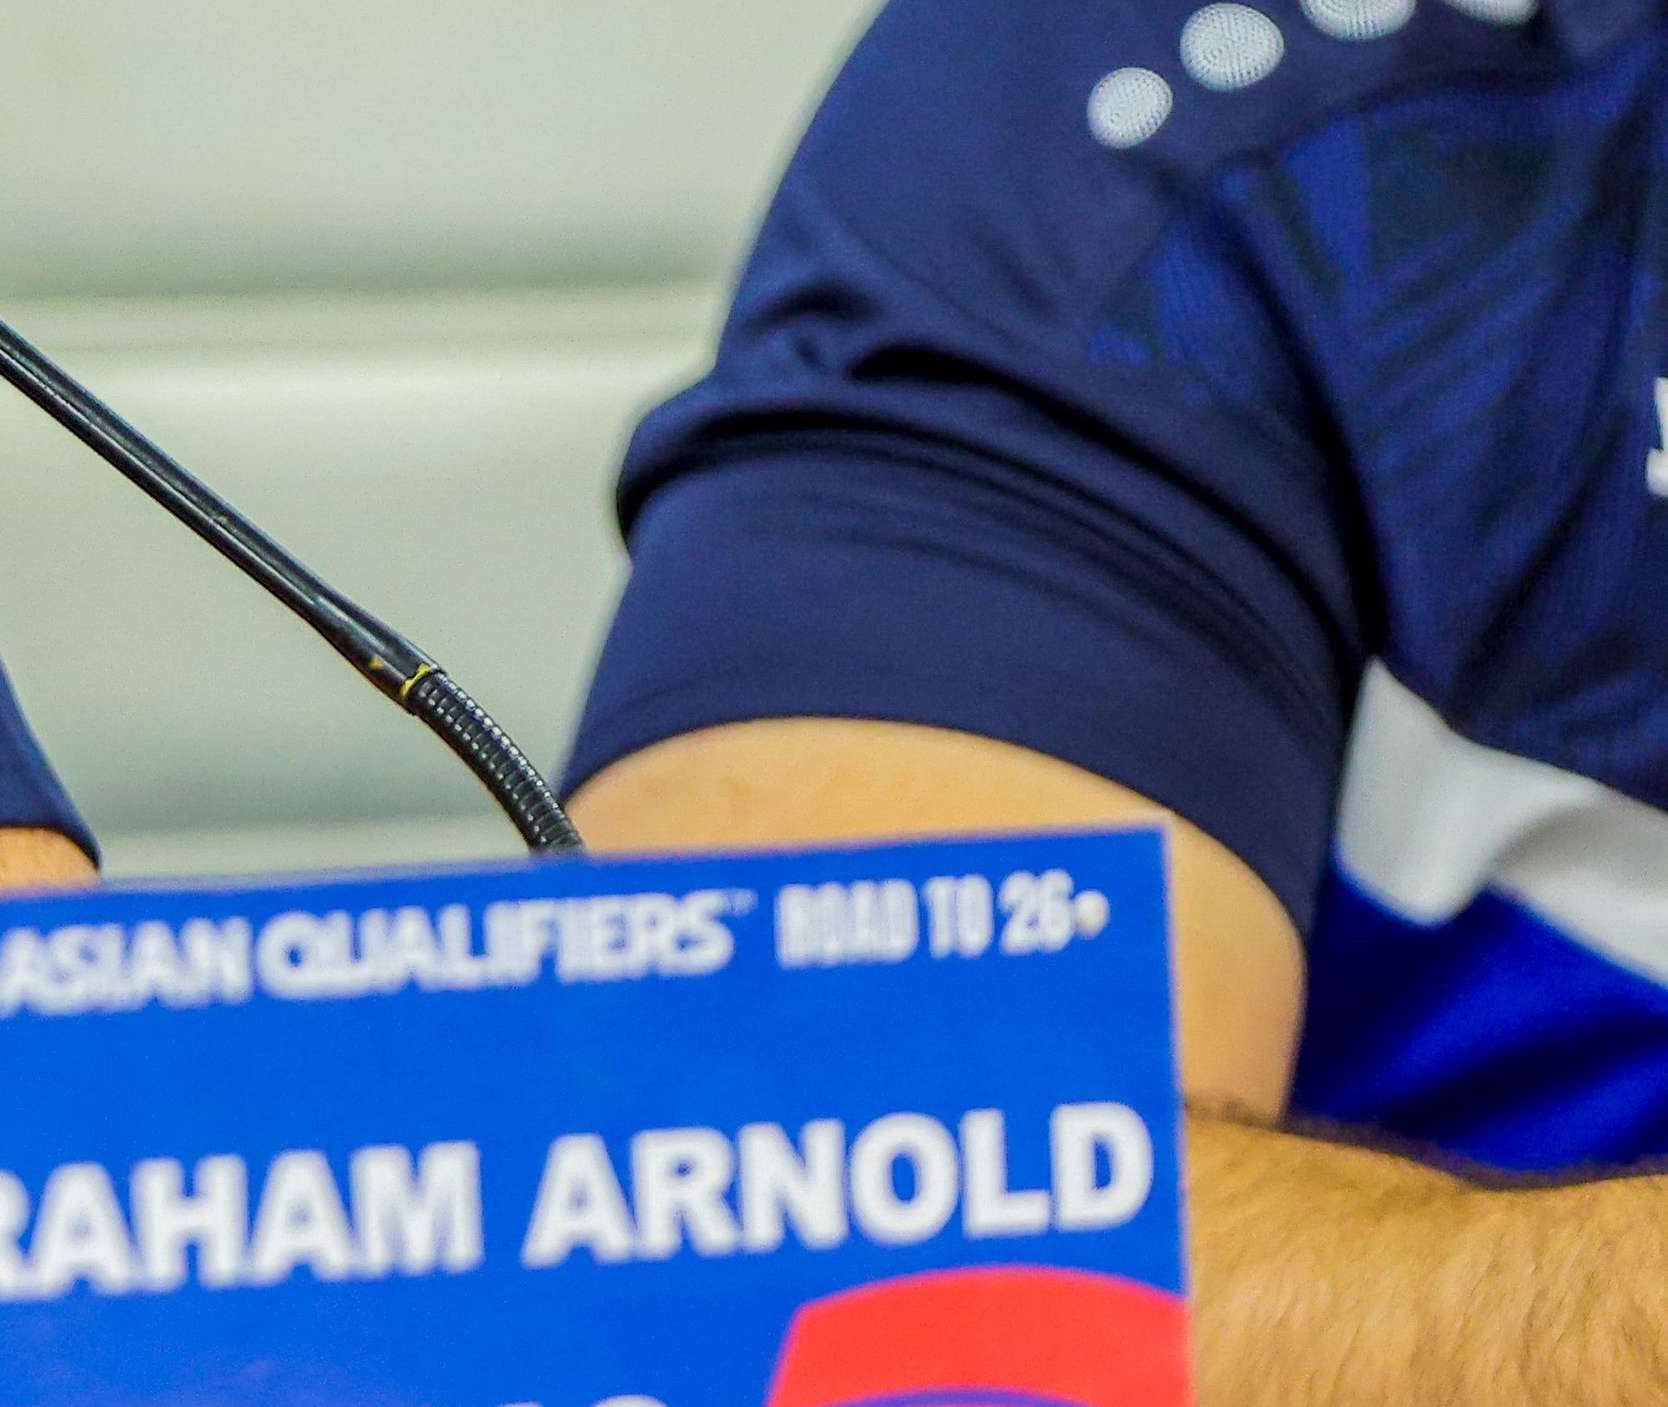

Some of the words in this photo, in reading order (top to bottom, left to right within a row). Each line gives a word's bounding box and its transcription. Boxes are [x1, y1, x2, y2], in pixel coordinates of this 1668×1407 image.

[775, 878, 918, 971] ROAD
[921, 875, 994, 958] TO
[519, 1100, 1156, 1271] ARNOLD
